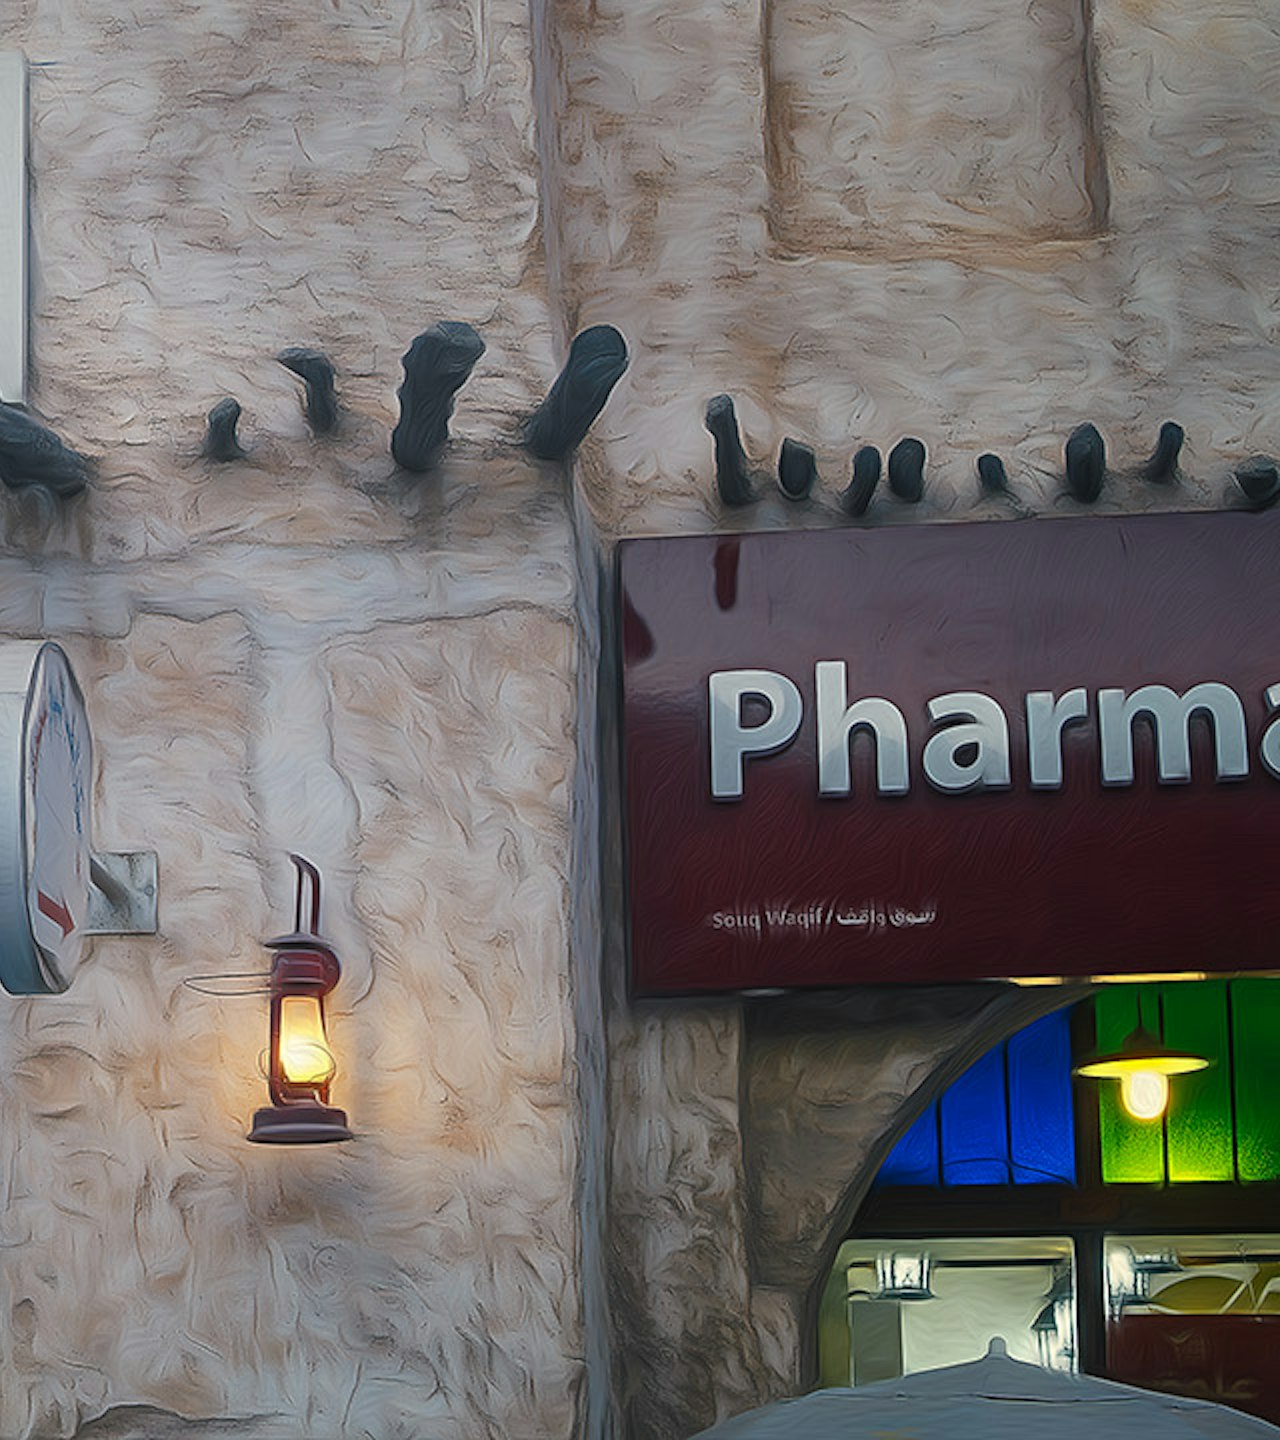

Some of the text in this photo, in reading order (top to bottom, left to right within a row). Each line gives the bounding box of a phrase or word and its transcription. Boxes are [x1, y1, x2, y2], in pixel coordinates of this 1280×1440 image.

[708, 660, 1280, 797] Pharm
[712, 912, 761, 931] Souq
[765, 907, 823, 929] Waqif
[836, 908, 886, 927] واقف
[889, 910, 936, 927] سوق
